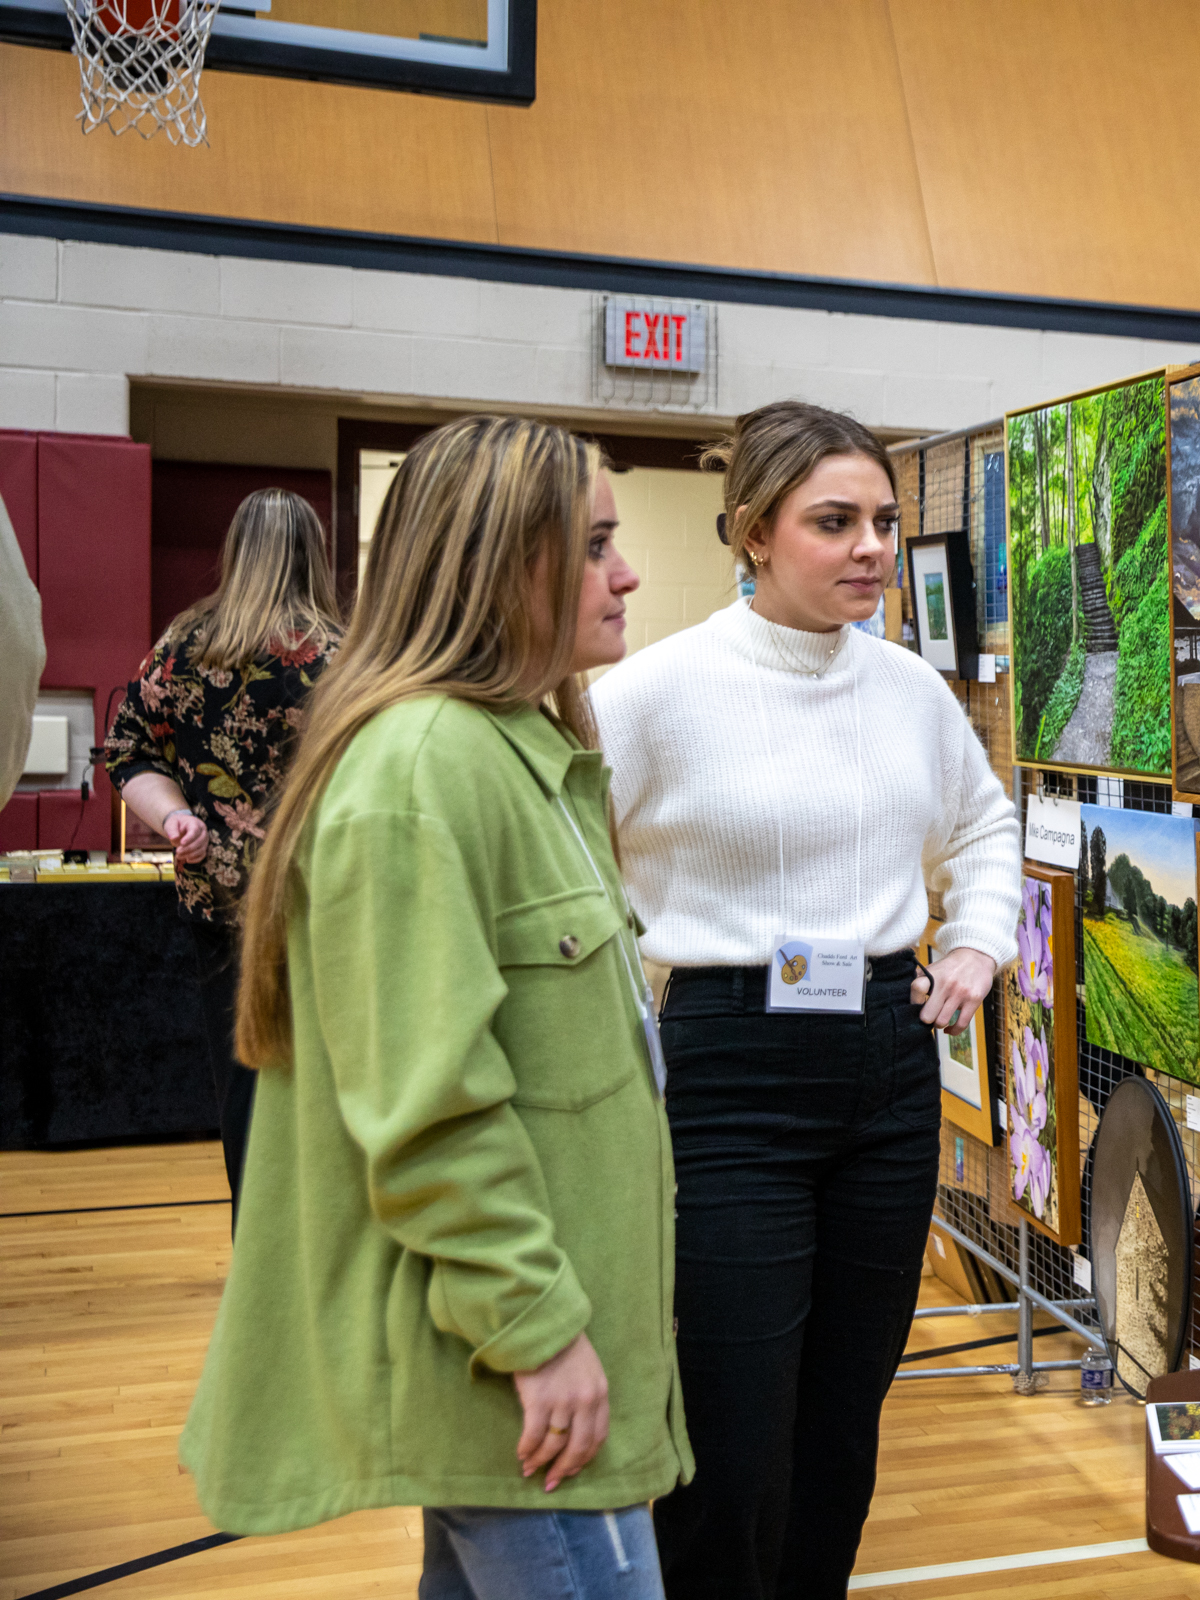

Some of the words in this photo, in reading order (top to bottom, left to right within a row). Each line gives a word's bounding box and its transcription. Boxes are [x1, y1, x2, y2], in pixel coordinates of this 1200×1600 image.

[625, 311, 687, 362] EXIT
[1029, 822, 1039, 838] Mike
[1040, 825, 1075, 847] Campagna
[797, 987, 848, 997] VOLUNTEER
